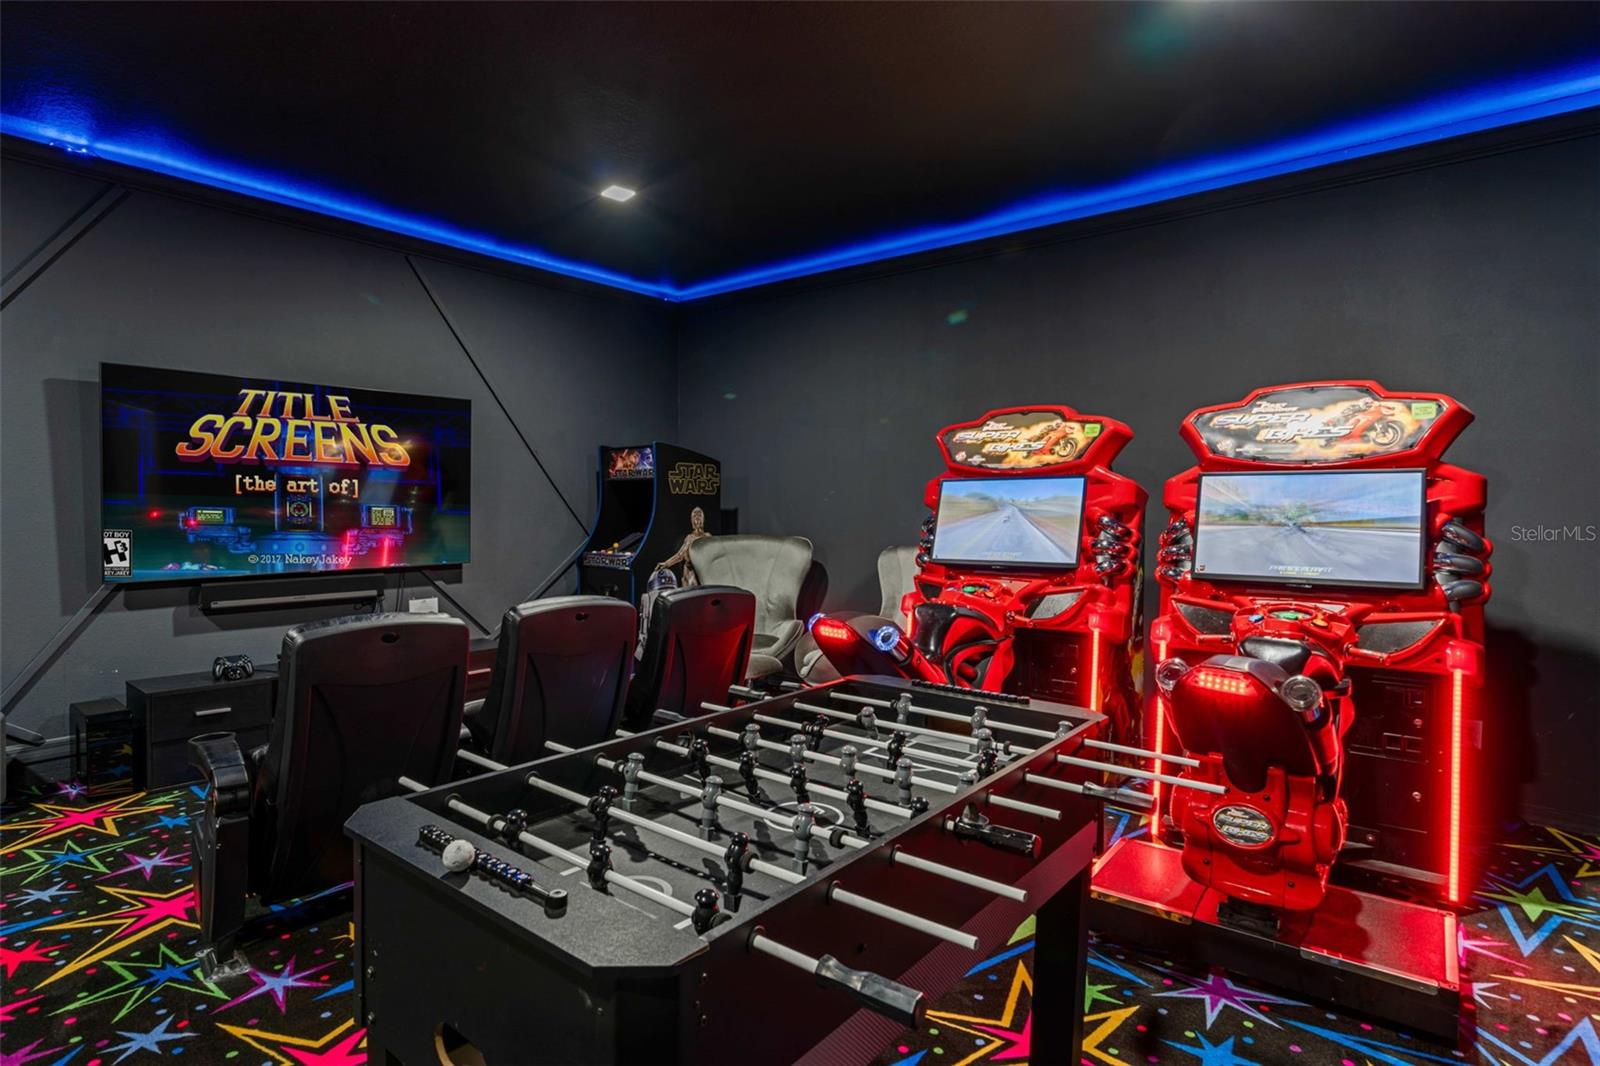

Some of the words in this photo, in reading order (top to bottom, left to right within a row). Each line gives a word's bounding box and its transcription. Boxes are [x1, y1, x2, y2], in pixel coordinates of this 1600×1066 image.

[233, 388, 360, 423] TITLE
[175, 413, 412, 467] SCREENS
[668, 462, 720, 479] STAR
[286, 478, 319, 494] art
[668, 477, 720, 494] WARS
[260, 554, 281, 565] 2017
